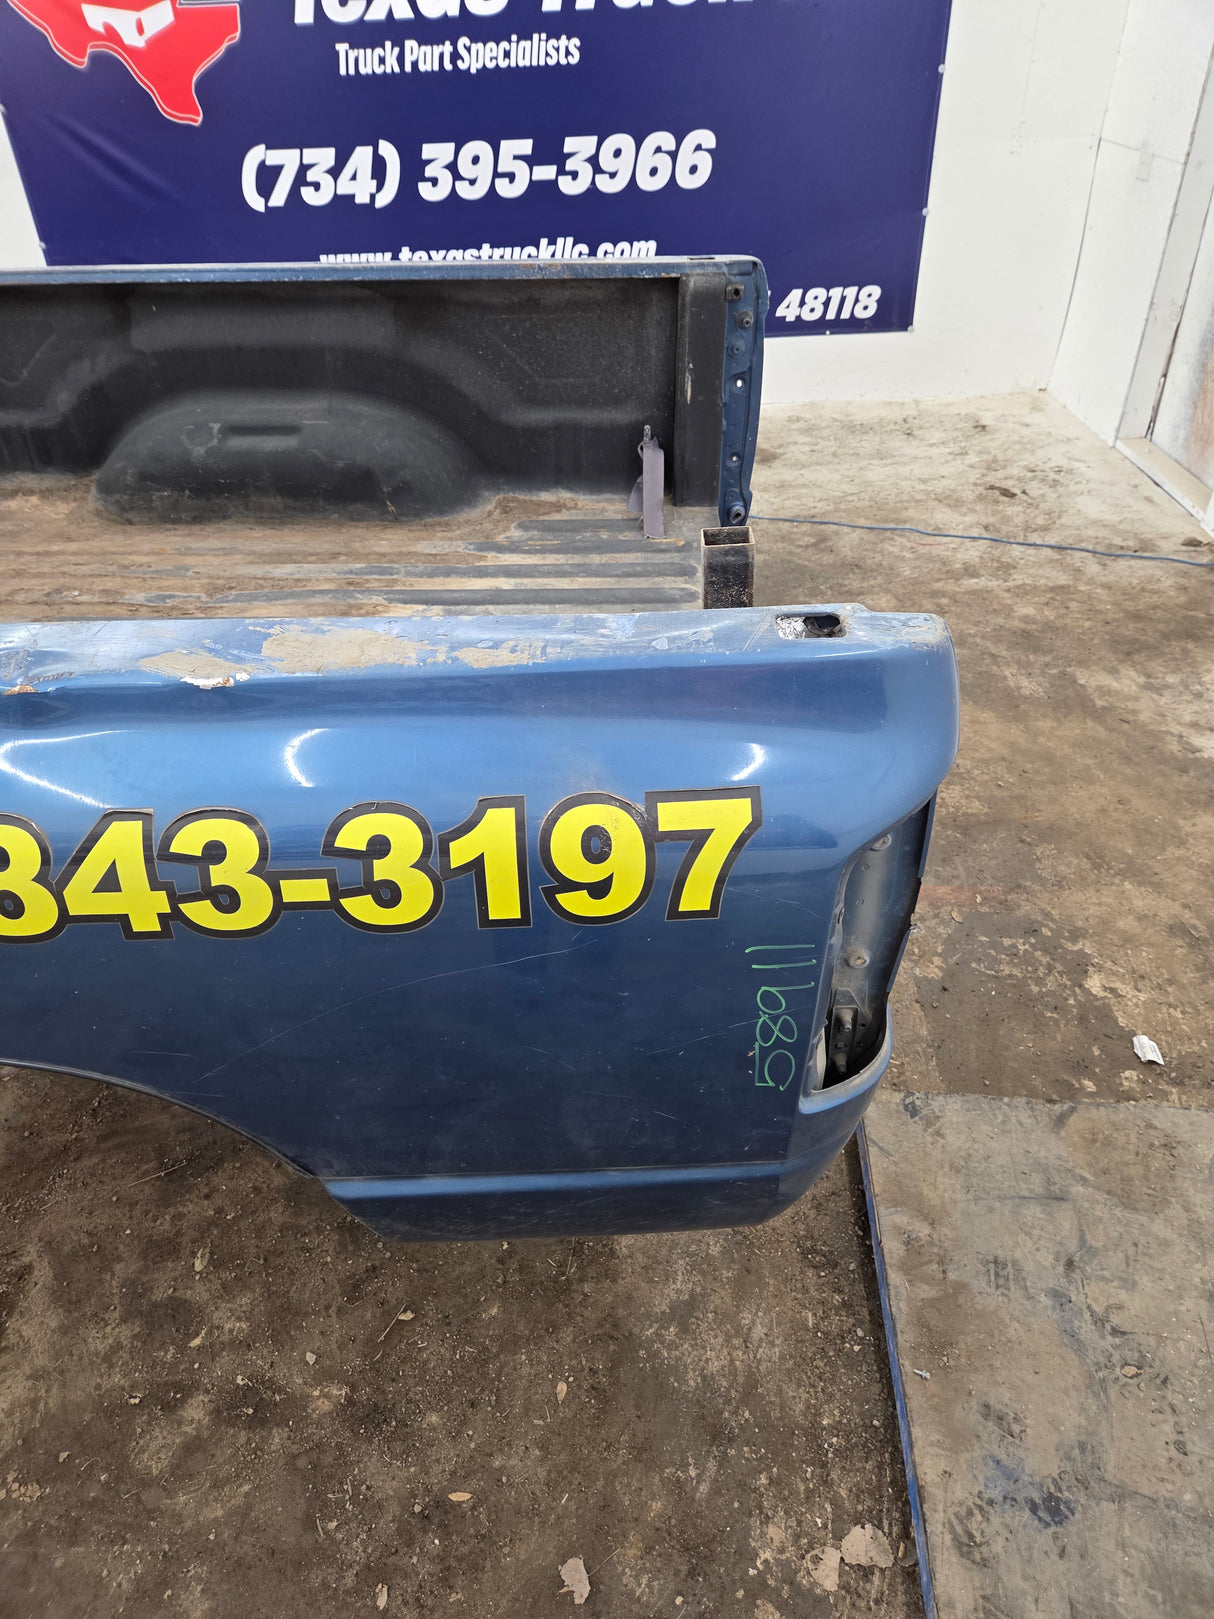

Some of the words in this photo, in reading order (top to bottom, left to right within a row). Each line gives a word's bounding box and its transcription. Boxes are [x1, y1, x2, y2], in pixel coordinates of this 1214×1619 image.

[335, 41, 400, 76] Truck
[404, 38, 453, 72] Part
[456, 33, 581, 73] Specialists
[241, 138, 401, 213] (734)
[417, 128, 717, 202] 395-3966
[775, 284, 882, 322] 48118
[745, 944, 817, 1092] 58911
